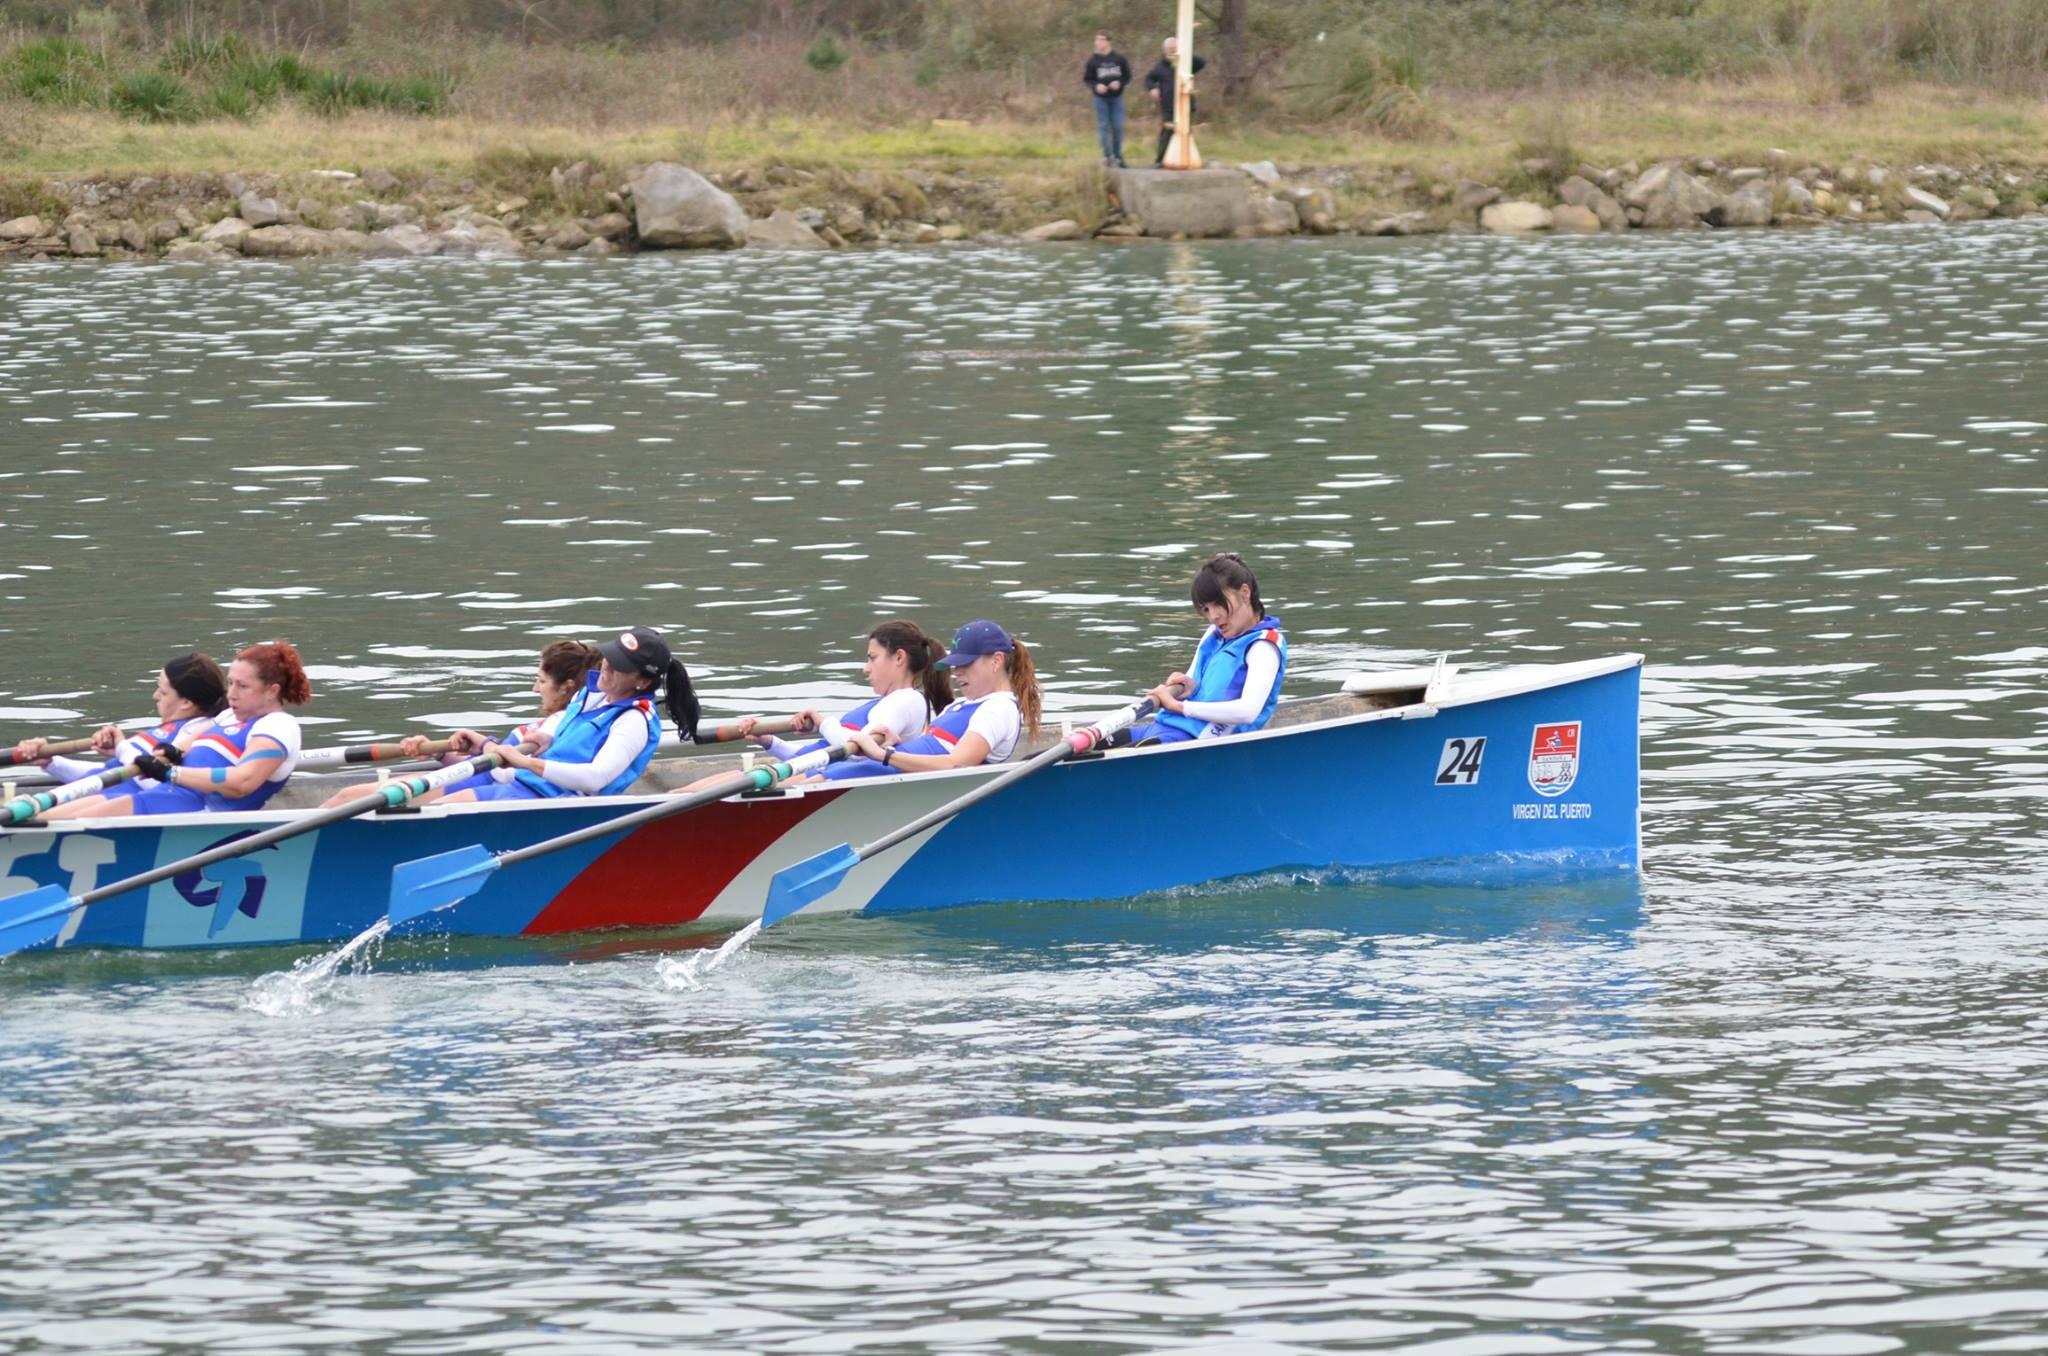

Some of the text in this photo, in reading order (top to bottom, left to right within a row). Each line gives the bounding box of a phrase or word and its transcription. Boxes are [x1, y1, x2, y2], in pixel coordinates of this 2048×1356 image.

[1437, 738, 1485, 784] 24
[1512, 803, 1592, 820] VIRGEN DEL PUERTO
